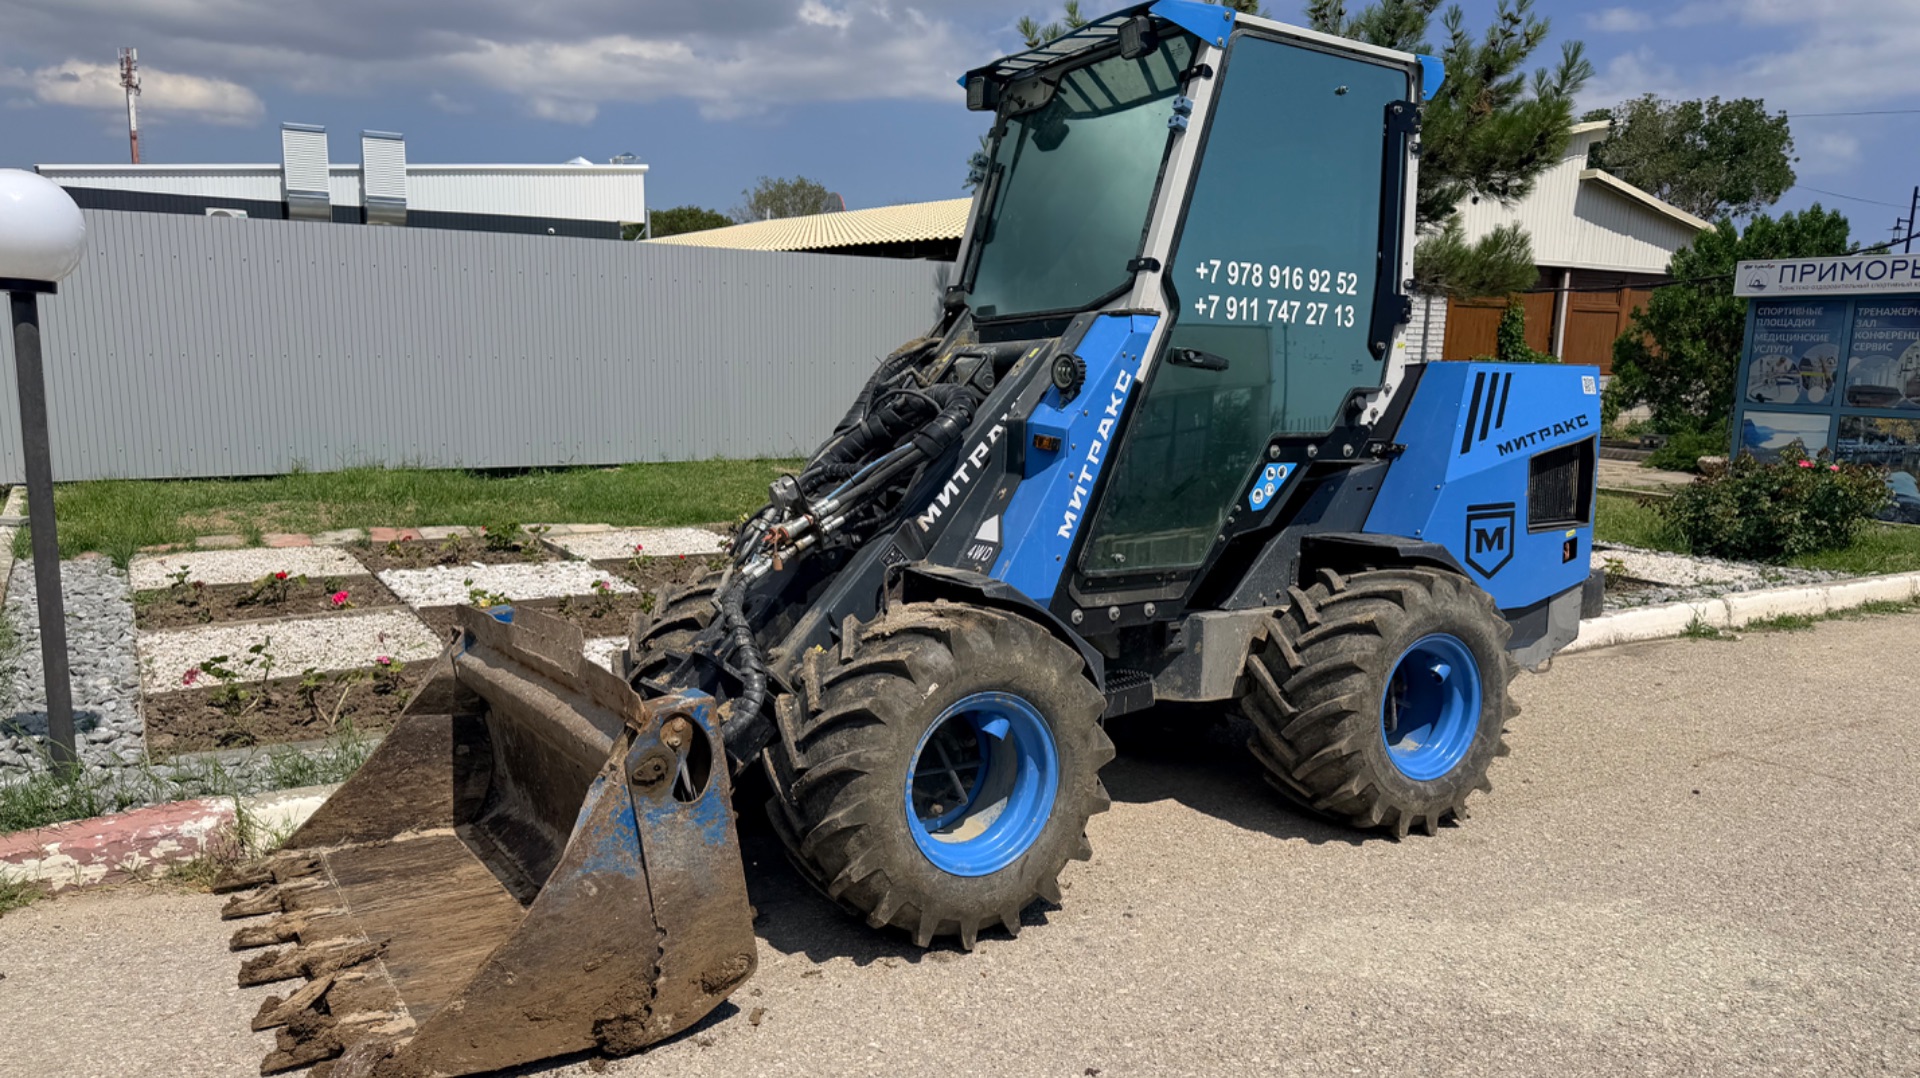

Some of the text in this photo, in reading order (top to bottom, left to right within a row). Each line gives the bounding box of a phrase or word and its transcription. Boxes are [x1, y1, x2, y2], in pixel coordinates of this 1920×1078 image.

[1195, 259, 1358, 296] +7 978 916 92 52
[1194, 295, 1355, 328] +7 911 747 27 13
[1757, 306, 1824, 316] СПОРТИВНЫЕ
[1755, 318, 1816, 328] ПЛОЩАДКИ
[1855, 319, 1877, 328] ЗАЛ
[1753, 332, 1830, 343] МЕДИЦИНСКИЕ
[1752, 344, 1793, 354] УСЛУГИ
[1852, 342, 1894, 352] СЕРВИС
[1495, 413, 1590, 457] МИТРАКС
[1057, 369, 1132, 539] МИТРАКС
[967, 544, 993, 562] 4WD
